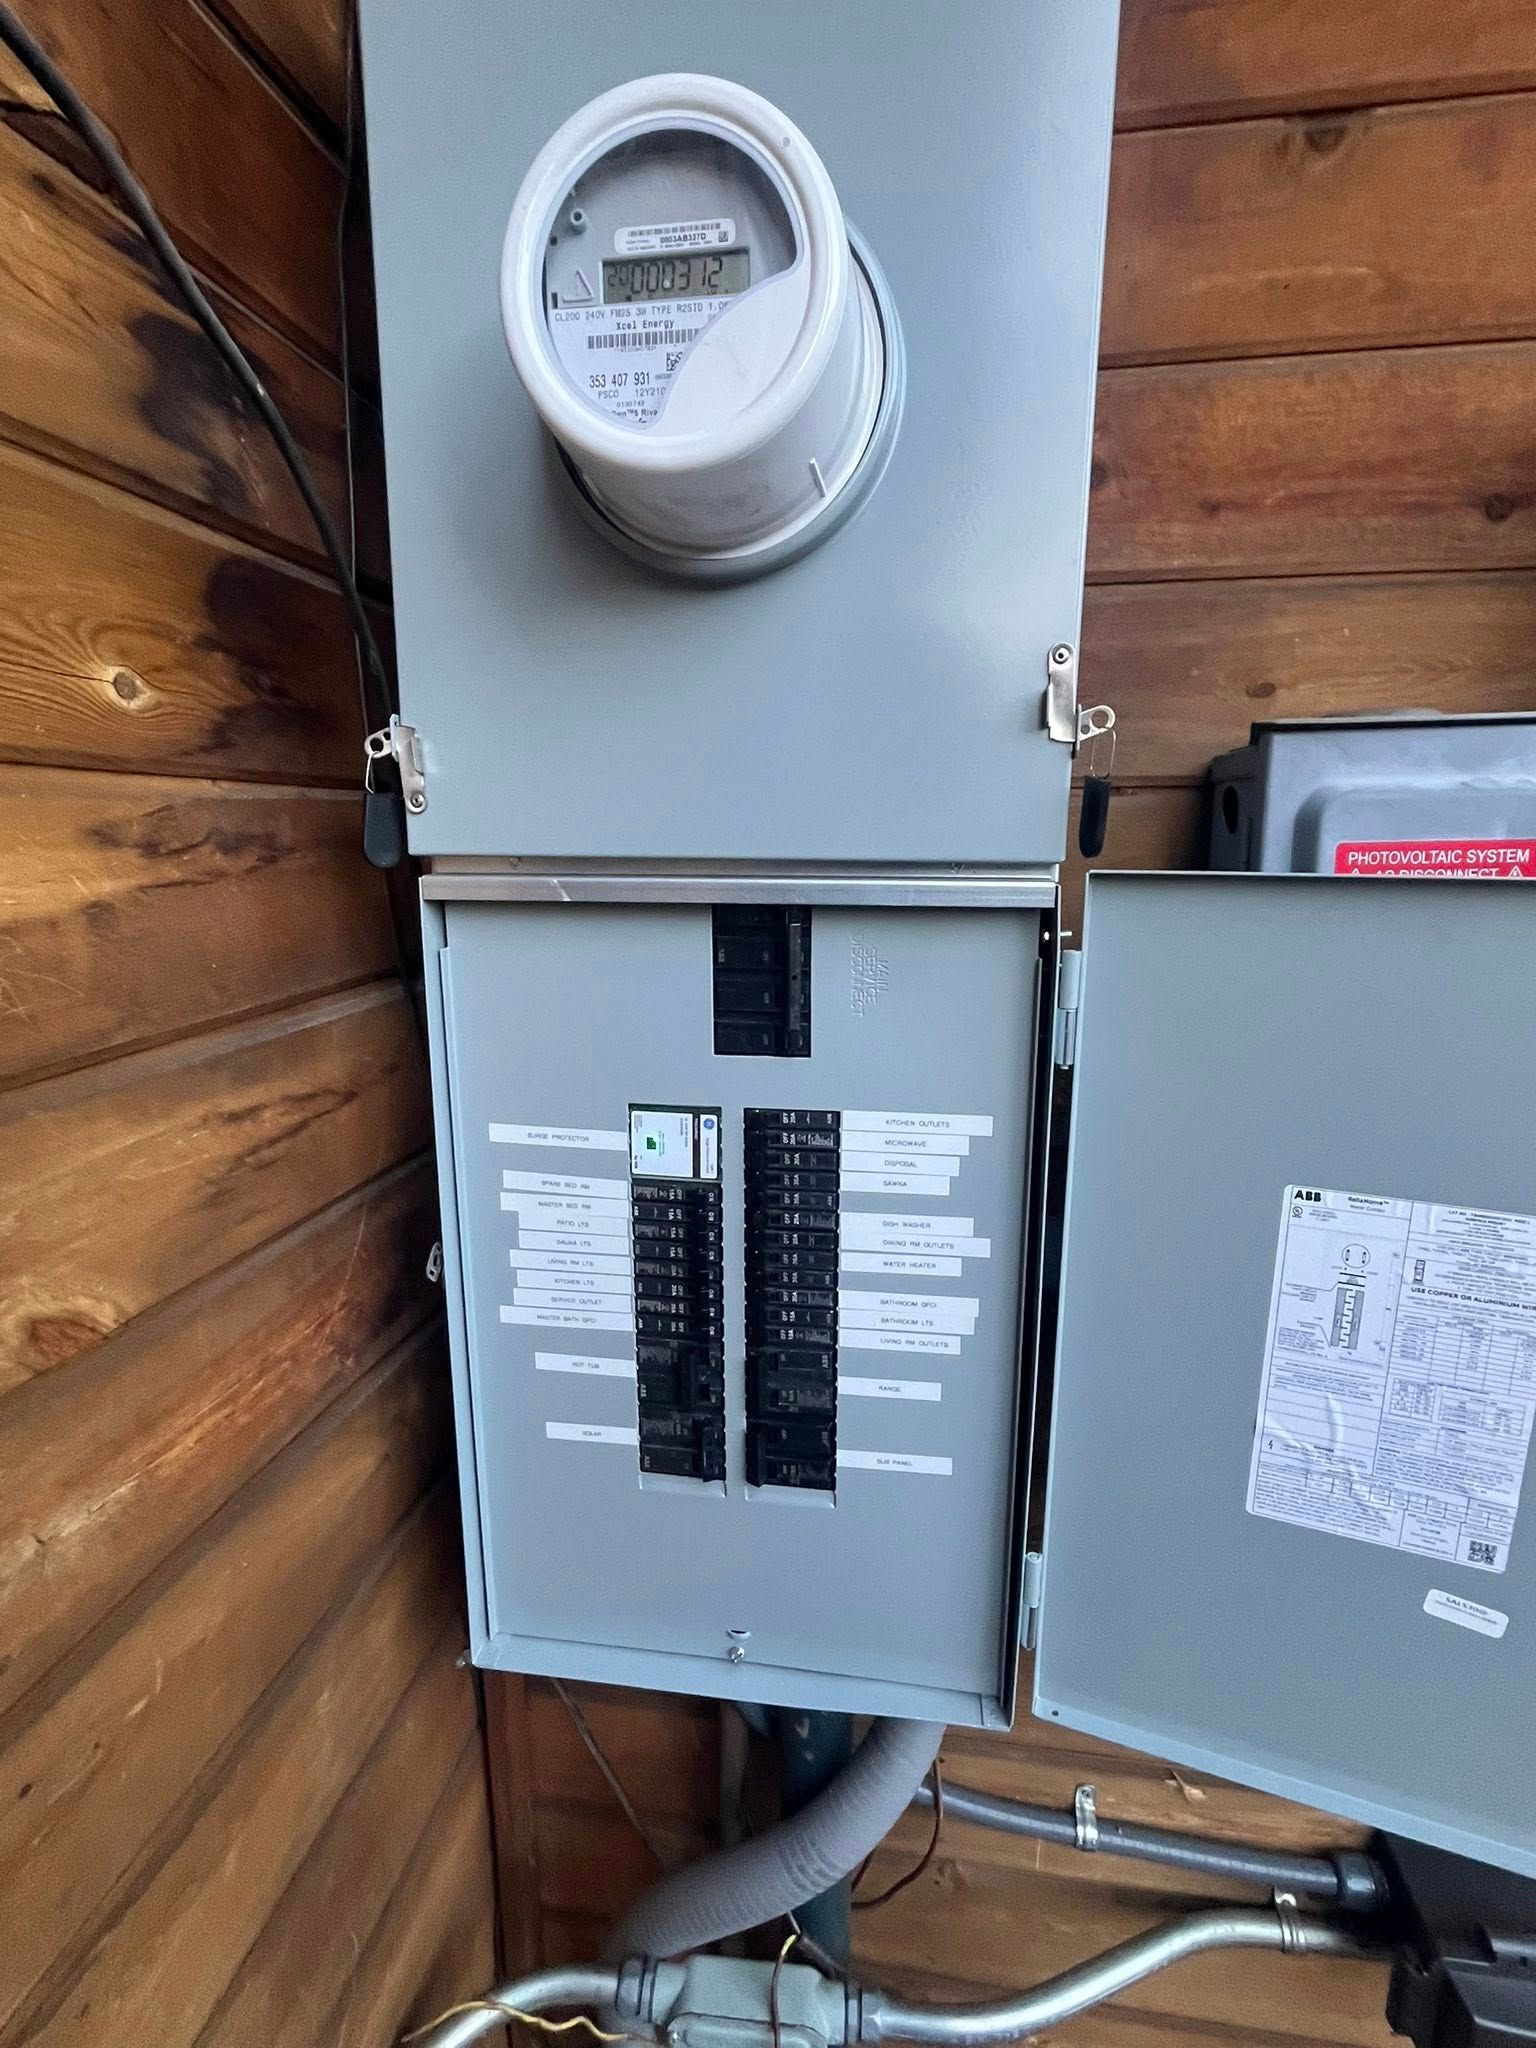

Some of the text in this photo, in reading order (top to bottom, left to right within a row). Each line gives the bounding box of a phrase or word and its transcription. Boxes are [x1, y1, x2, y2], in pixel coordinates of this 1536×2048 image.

[555, 312, 580, 322] CL200
[585, 310, 605, 320] 240V
[651, 304, 672, 314] TYPE
[616, 319, 675, 331] Xcel Energy
[589, 374, 606, 389] 353
[611, 373, 628, 387] 407
[634, 372, 650, 386] 931
[1347, 849, 1530, 865] PHOTOVOLTAIC SYSTEM
[885, 1118, 950, 1128] KITCHEN OUTLETS
[552, 1133, 590, 1143] PROTECTOR
[884, 1139, 927, 1148] MICROWAVE
[884, 1160, 918, 1168] DISPOSAL
[564, 1181, 577, 1189] BED
[580, 1182, 590, 1190] RM
[1294, 1190, 1321, 1202] ABB
[538, 1200, 592, 1211] MASTER BED RM
[556, 1219, 590, 1228] PATIO LTS
[882, 1220, 931, 1230] DISH WASHER
[580, 1240, 592, 1248] LTS
[882, 1239, 954, 1250] DINING RM OUTLETS
[582, 1260, 594, 1268] LTS
[882, 1260, 936, 1270] WATER HEATER
[554, 1277, 580, 1286] KITCHEN
[550, 1296, 602, 1306] SERVICE OUTLET
[1411, 1286, 1425, 1294] USE
[1427, 1289, 1459, 1299] COPPER
[1474, 1297, 1520, 1309] ALUMINIUM
[880, 1298, 918, 1308] BATHROOM
[536, 1314, 560, 1322] MASTER
[563, 1315, 580, 1323] BATH
[880, 1317, 934, 1327] BATHROOM LTS
[918, 1340, 949, 1348] OUTLETS
[878, 1384, 901, 1392] RANGE
[876, 1458, 913, 1467] SUB PANEL
